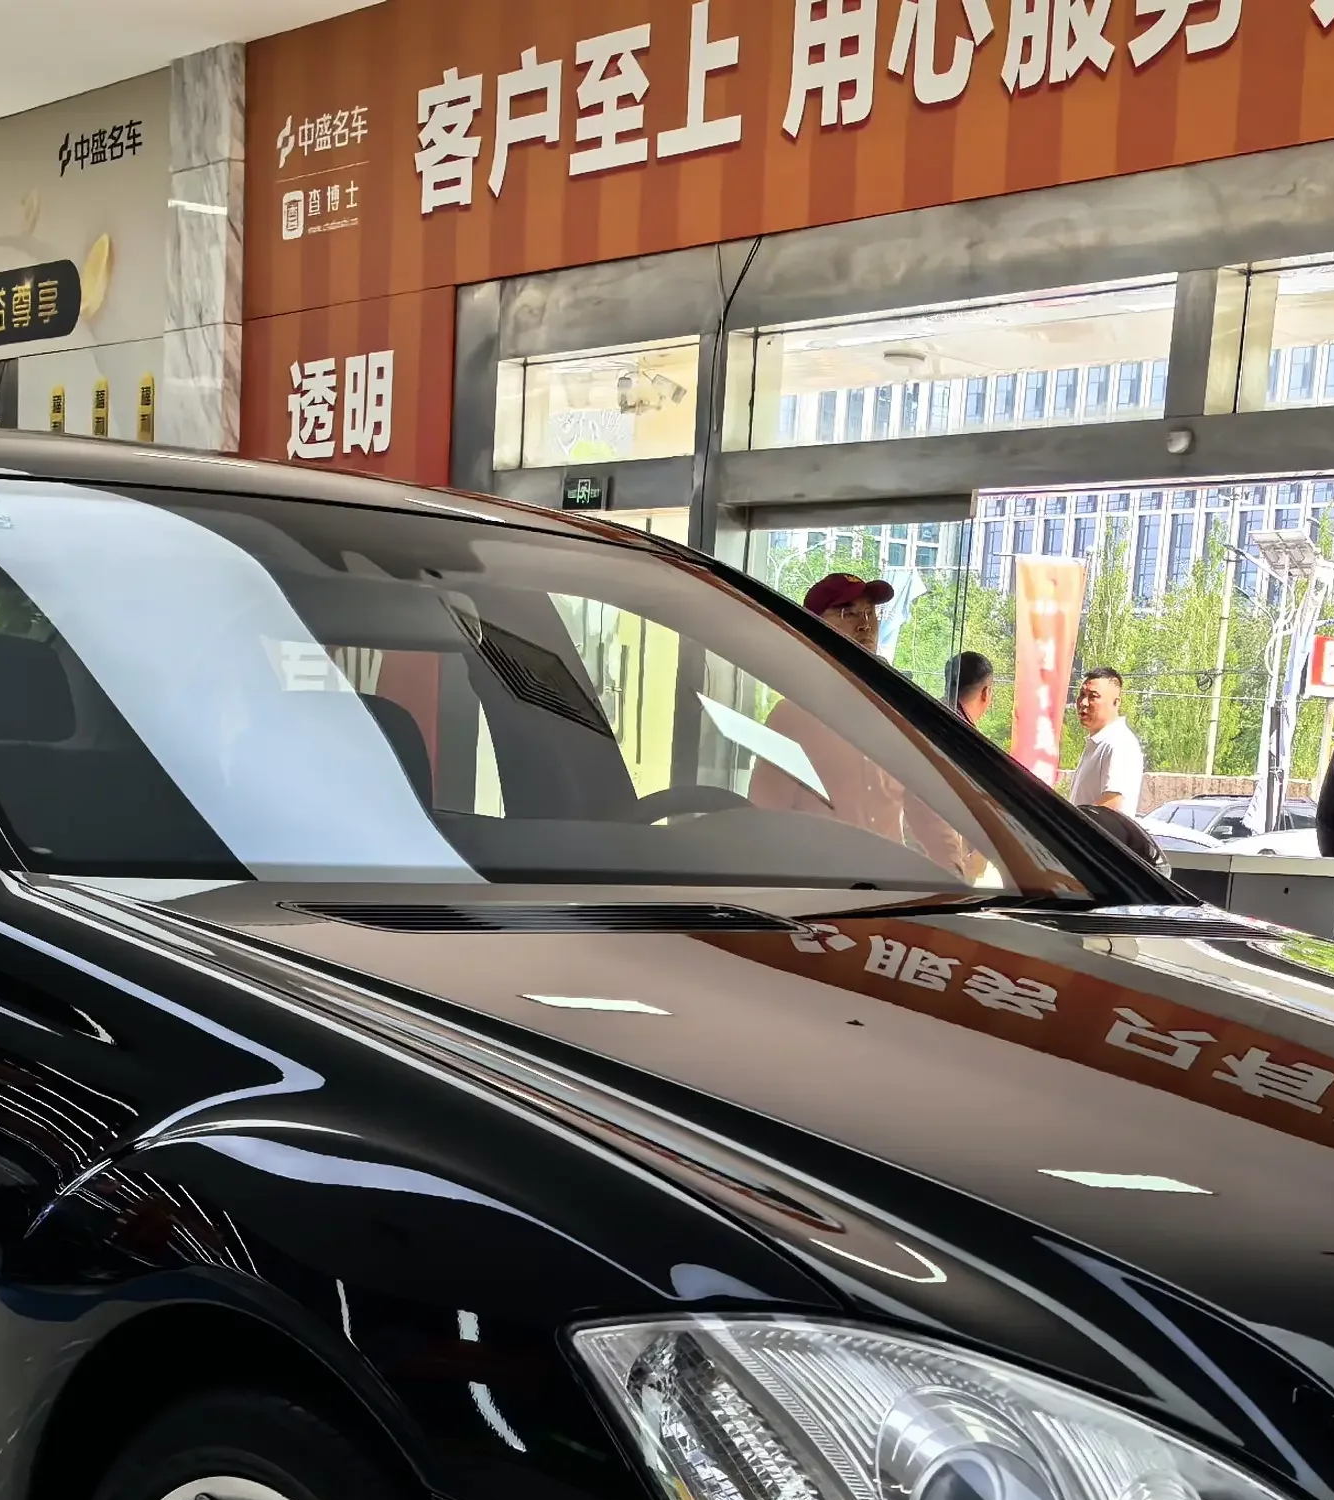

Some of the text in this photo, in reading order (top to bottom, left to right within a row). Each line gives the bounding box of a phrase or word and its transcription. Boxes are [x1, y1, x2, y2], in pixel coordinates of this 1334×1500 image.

[298, 105, 369, 157] 中盛名车
[414, 0, 742, 215] 客户至上
[73, 119, 144, 170] 中盛名车
[307, 180, 360, 217] 查博士
[287, 349, 395, 460] 透明
